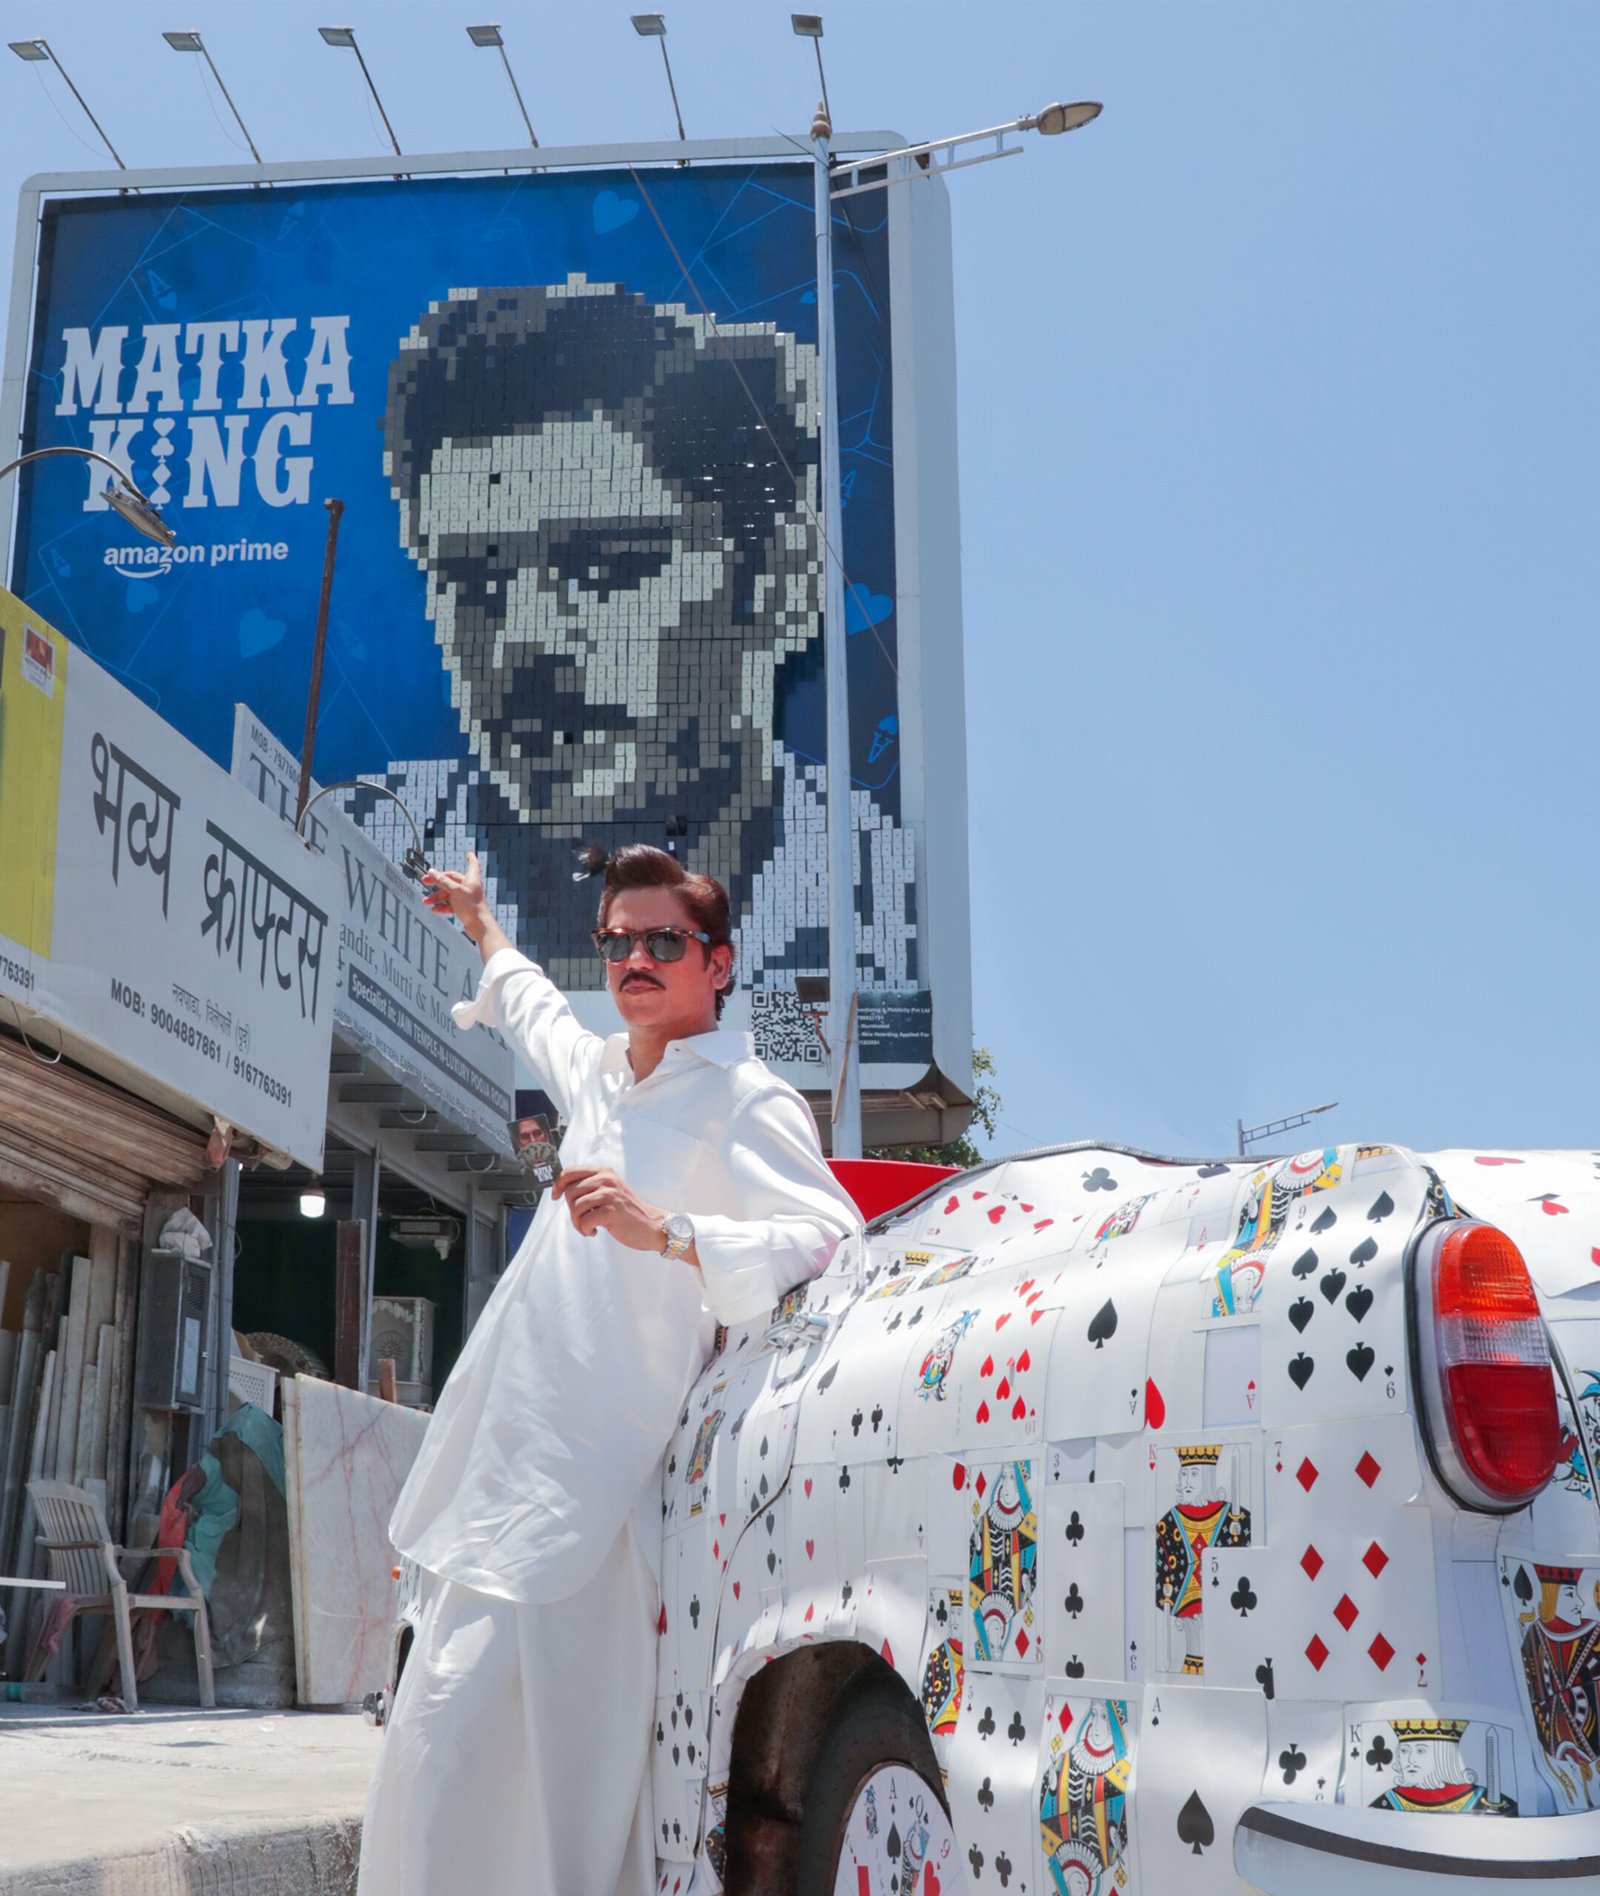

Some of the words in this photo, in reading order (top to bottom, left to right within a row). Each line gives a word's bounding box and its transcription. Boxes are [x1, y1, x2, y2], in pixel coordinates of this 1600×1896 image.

[55, 315, 355, 416] MATKA
[103, 544, 205, 567] amazon
[211, 538, 289, 567] prime
[90, 731, 182, 922] भव्य
[341, 843, 450, 998] WHITE
[340, 922, 378, 973] andir,
[382, 951, 413, 997] Murti
[416, 983, 427, 1011] &
[430, 993, 457, 1038] More
[351, 972, 387, 1016] Specialist
[111, 977, 146, 1018] MOB:
[151, 1003, 221, 1064] 9004887861
[233, 1056, 293, 1109] 9167763391
[1053, 1453, 1061, 1467] 3
[1148, 1444, 1157, 1460] K
[1274, 1441, 1282, 1457] 7
[1211, 1557, 1219, 1573] 5
[1500, 1556, 1507, 1573] J
[1130, 1655, 1138, 1670] 3
[1417, 1670, 1427, 1687] 7
[1152, 1697, 1162, 1713] A
[1349, 1724, 1361, 1743] K
[888, 1775, 897, 1800] A
[915, 1794, 924, 1824] Q
